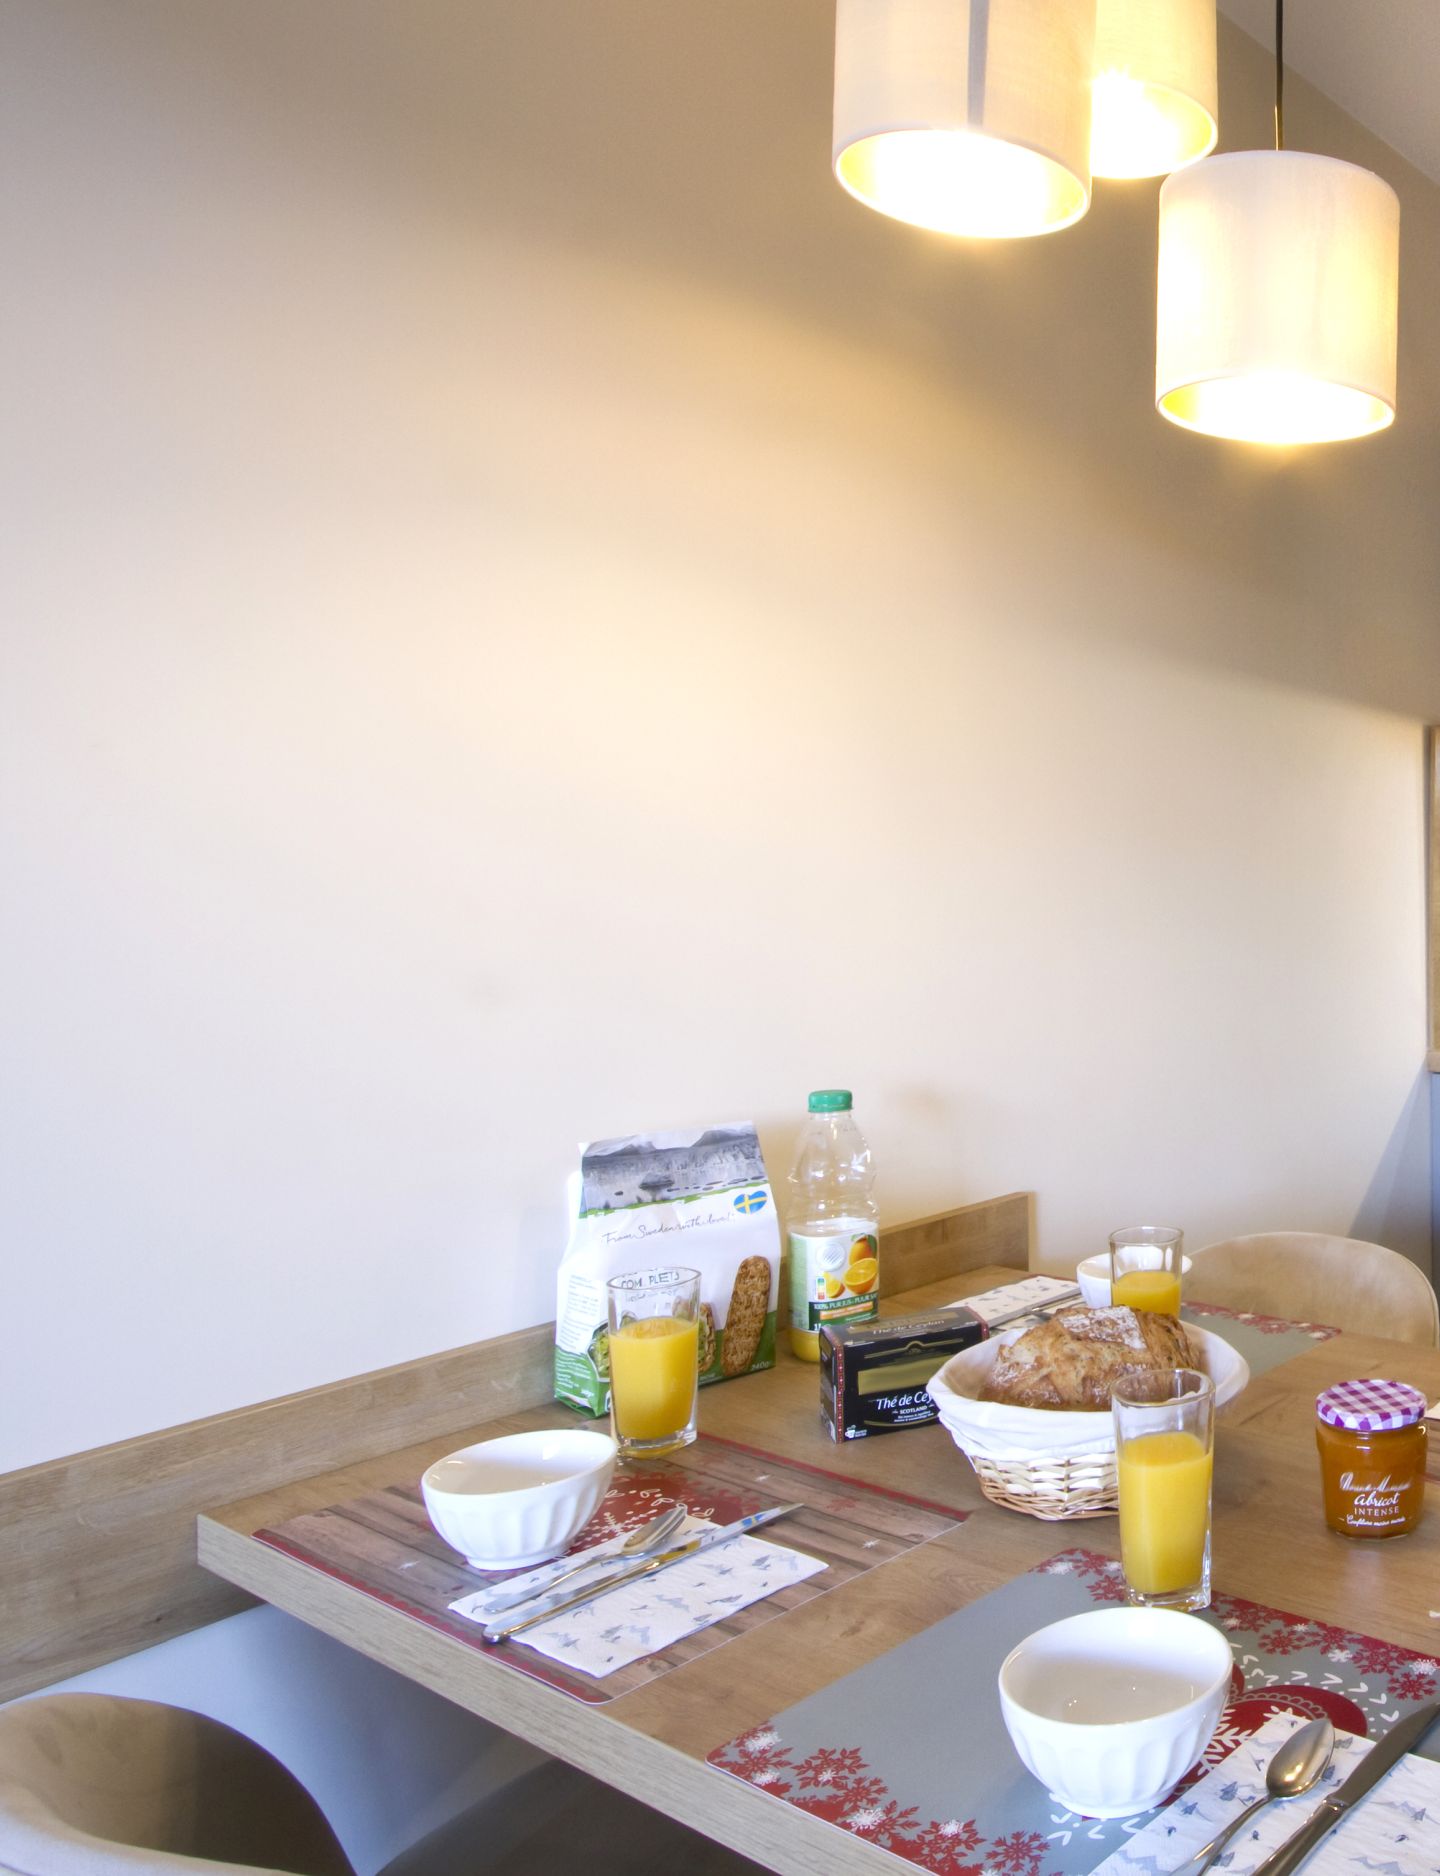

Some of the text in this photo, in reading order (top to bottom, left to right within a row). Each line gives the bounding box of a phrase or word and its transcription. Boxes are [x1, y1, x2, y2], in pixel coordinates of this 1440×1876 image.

[637, 1222, 675, 1239] Sweden
[876, 1391, 933, 1410] Thé de Cey
[899, 1405, 928, 1414] SCOTLAND
[1354, 1506, 1399, 1516] INTENSE
